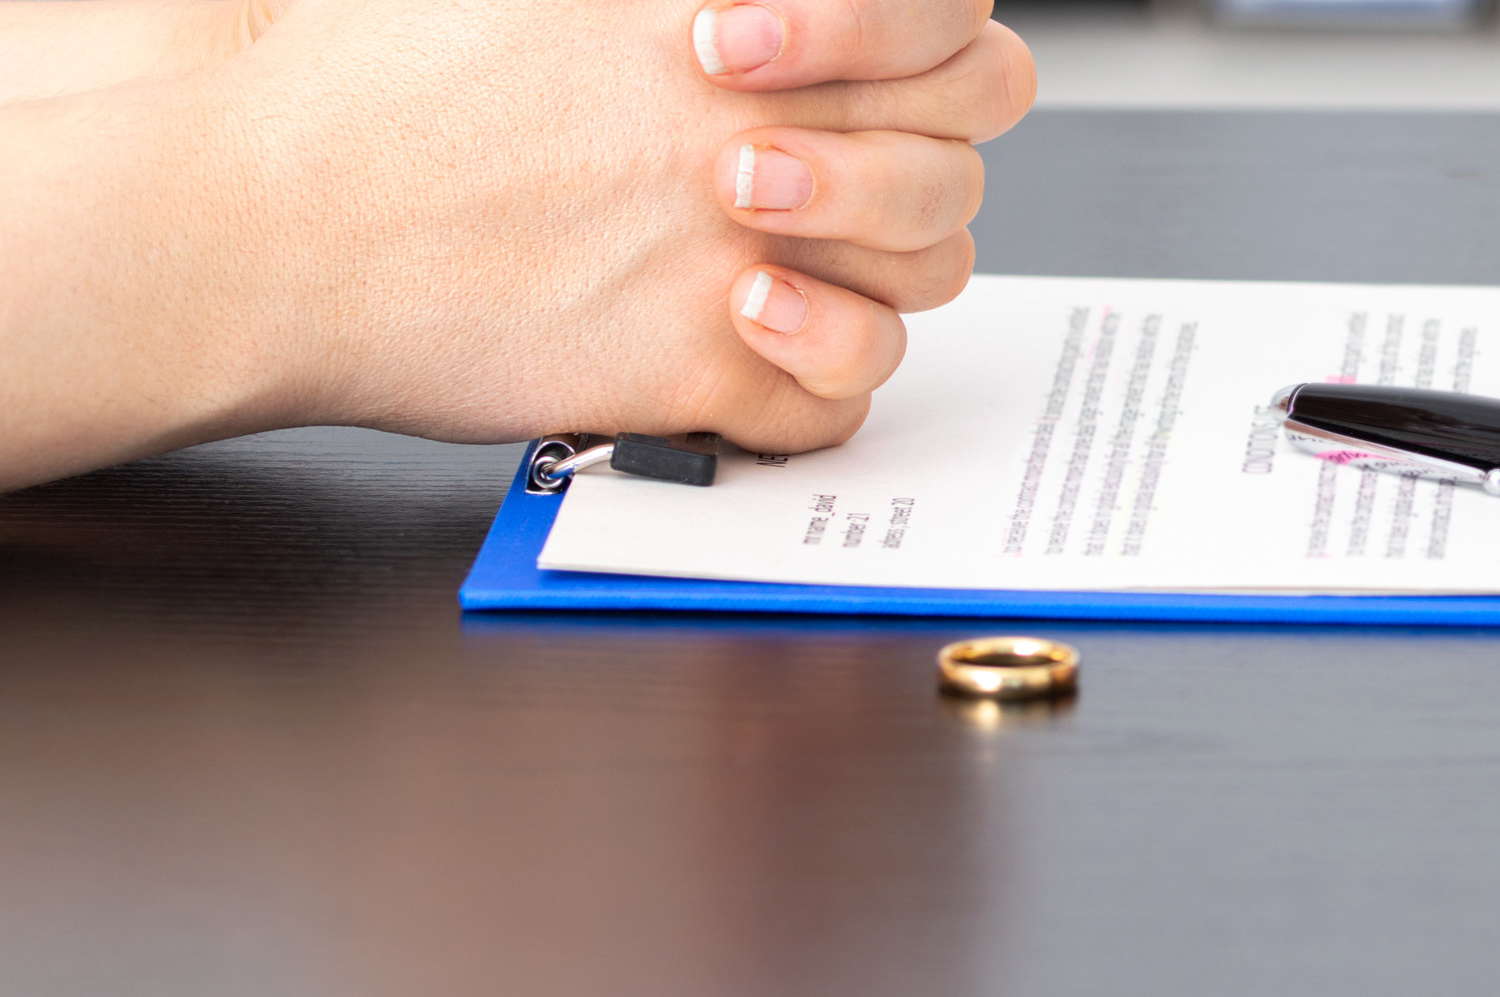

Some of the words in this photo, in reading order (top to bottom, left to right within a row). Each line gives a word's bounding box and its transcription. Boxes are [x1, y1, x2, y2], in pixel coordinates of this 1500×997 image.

[891, 497, 915, 505] 20
[890, 507, 912, 524] street
[806, 517, 829, 535] name
[840, 522, 866, 548] number
